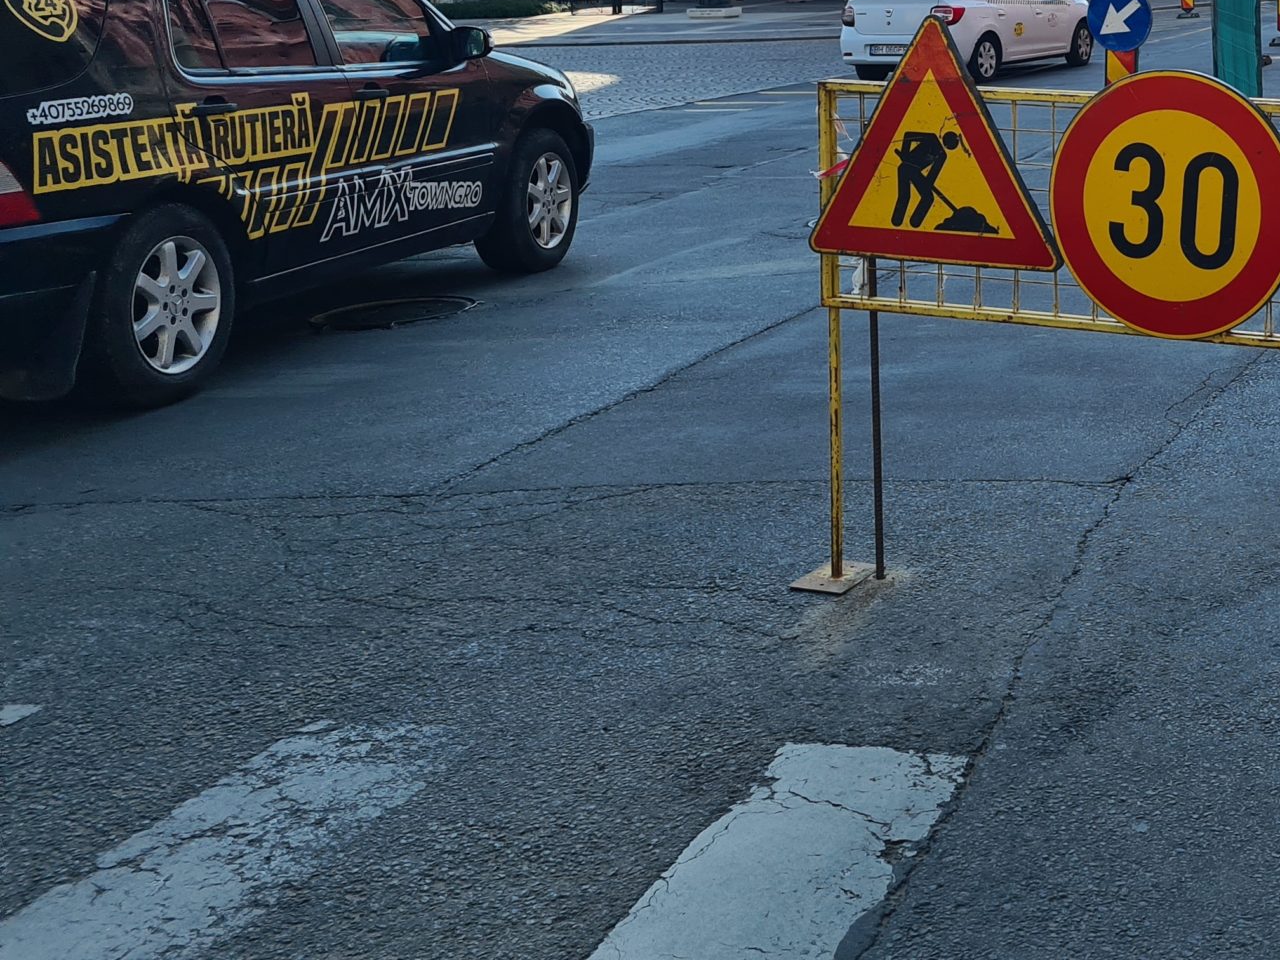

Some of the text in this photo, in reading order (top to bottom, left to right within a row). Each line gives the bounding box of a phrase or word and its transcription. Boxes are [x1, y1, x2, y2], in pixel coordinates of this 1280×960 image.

[28, 94, 133, 123] +40755269869
[320, 167, 413, 242] AMX
[1109, 142, 1239, 270] 30
